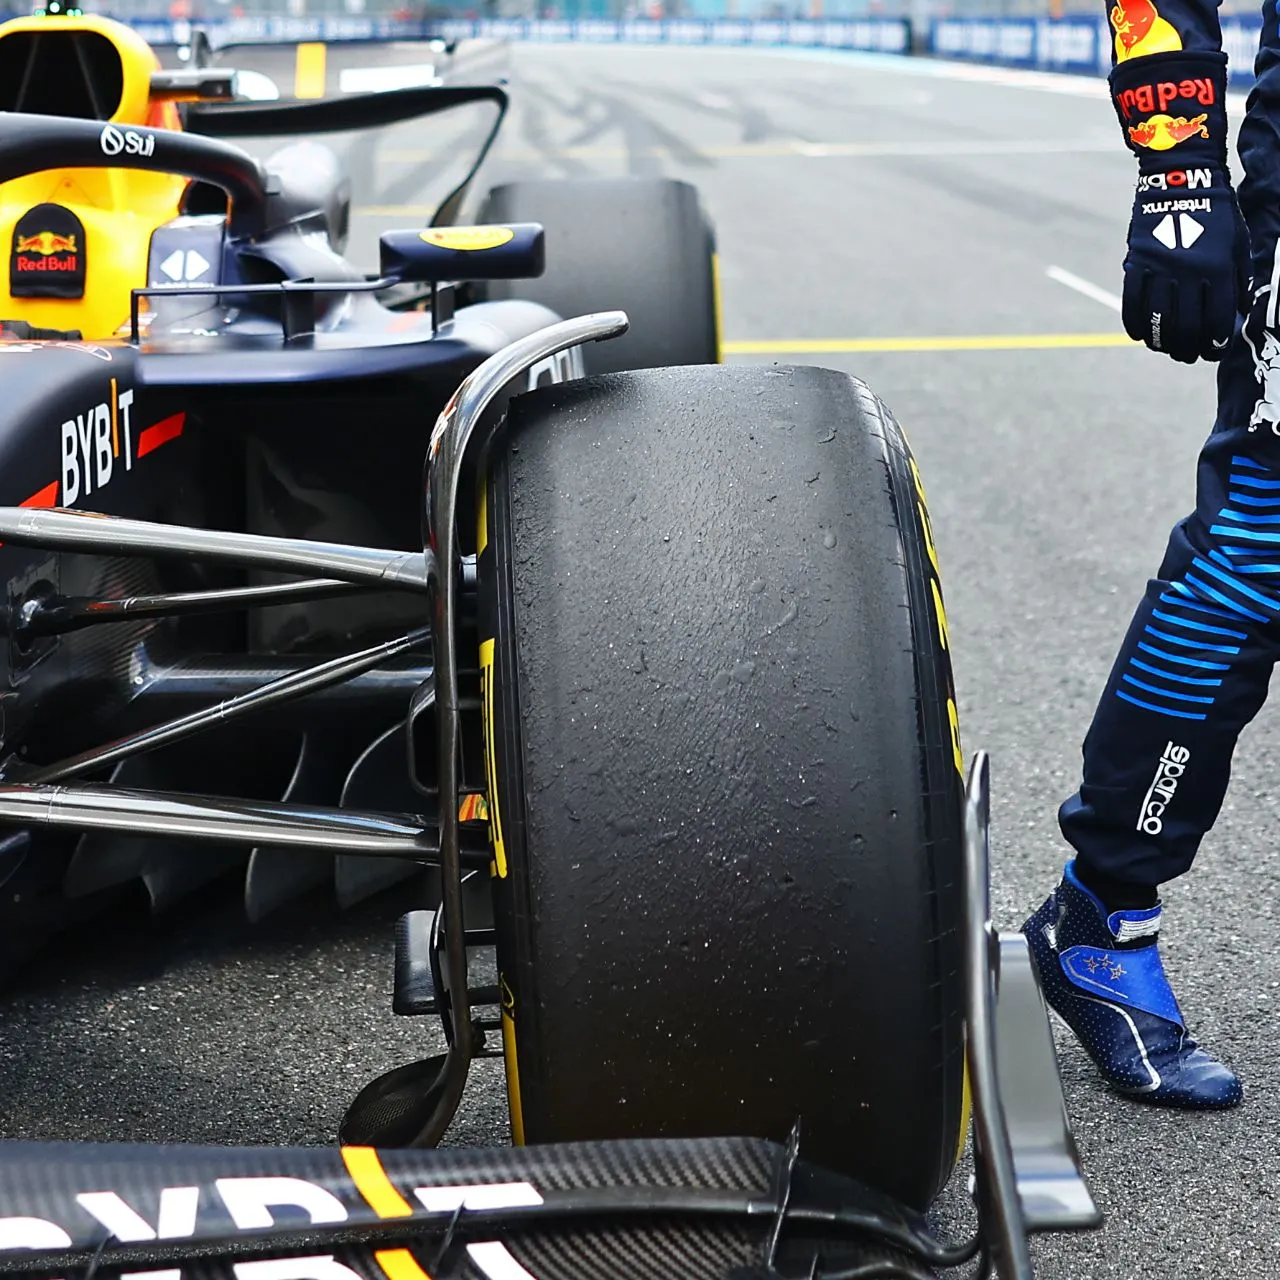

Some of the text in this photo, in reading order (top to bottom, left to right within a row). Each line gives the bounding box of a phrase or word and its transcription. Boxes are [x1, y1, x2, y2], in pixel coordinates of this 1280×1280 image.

[1158, 78, 1215, 113] Red
[124, 130, 155, 158] Sui
[17, 256, 77, 272] Red Bull
[61, 377, 135, 508] BYBIT
[1136, 741, 1191, 835] sparco
